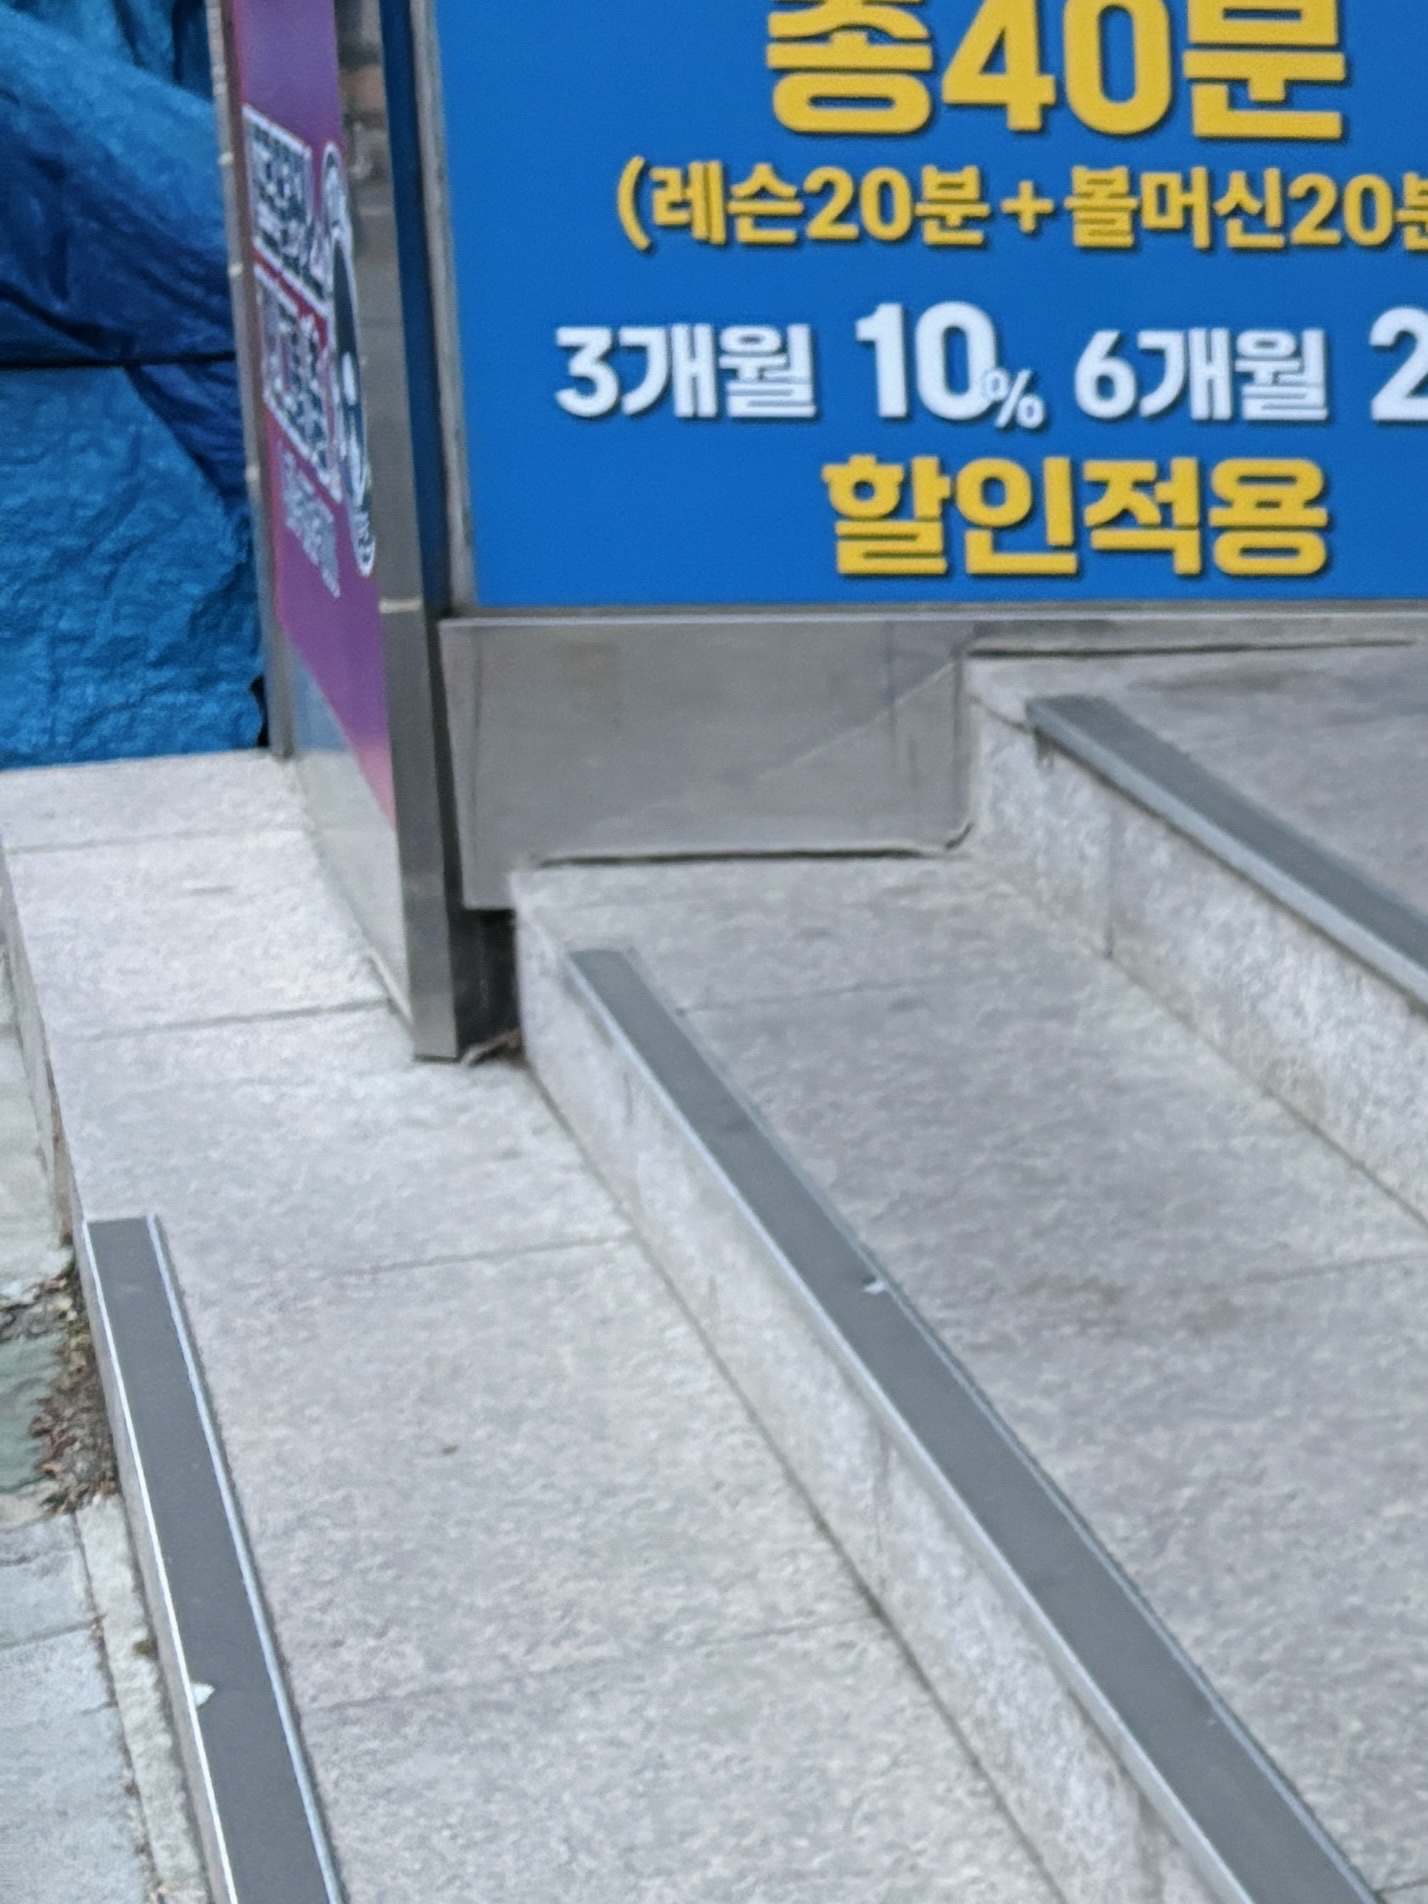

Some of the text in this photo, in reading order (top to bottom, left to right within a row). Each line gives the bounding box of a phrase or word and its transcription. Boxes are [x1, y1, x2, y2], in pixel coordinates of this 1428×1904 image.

[554, 323, 818, 420] 3개월
[854, 300, 1046, 431] 10%
[1072, 327, 1330, 424] 6개월
[821, 453, 1330, 577] 할인적용
